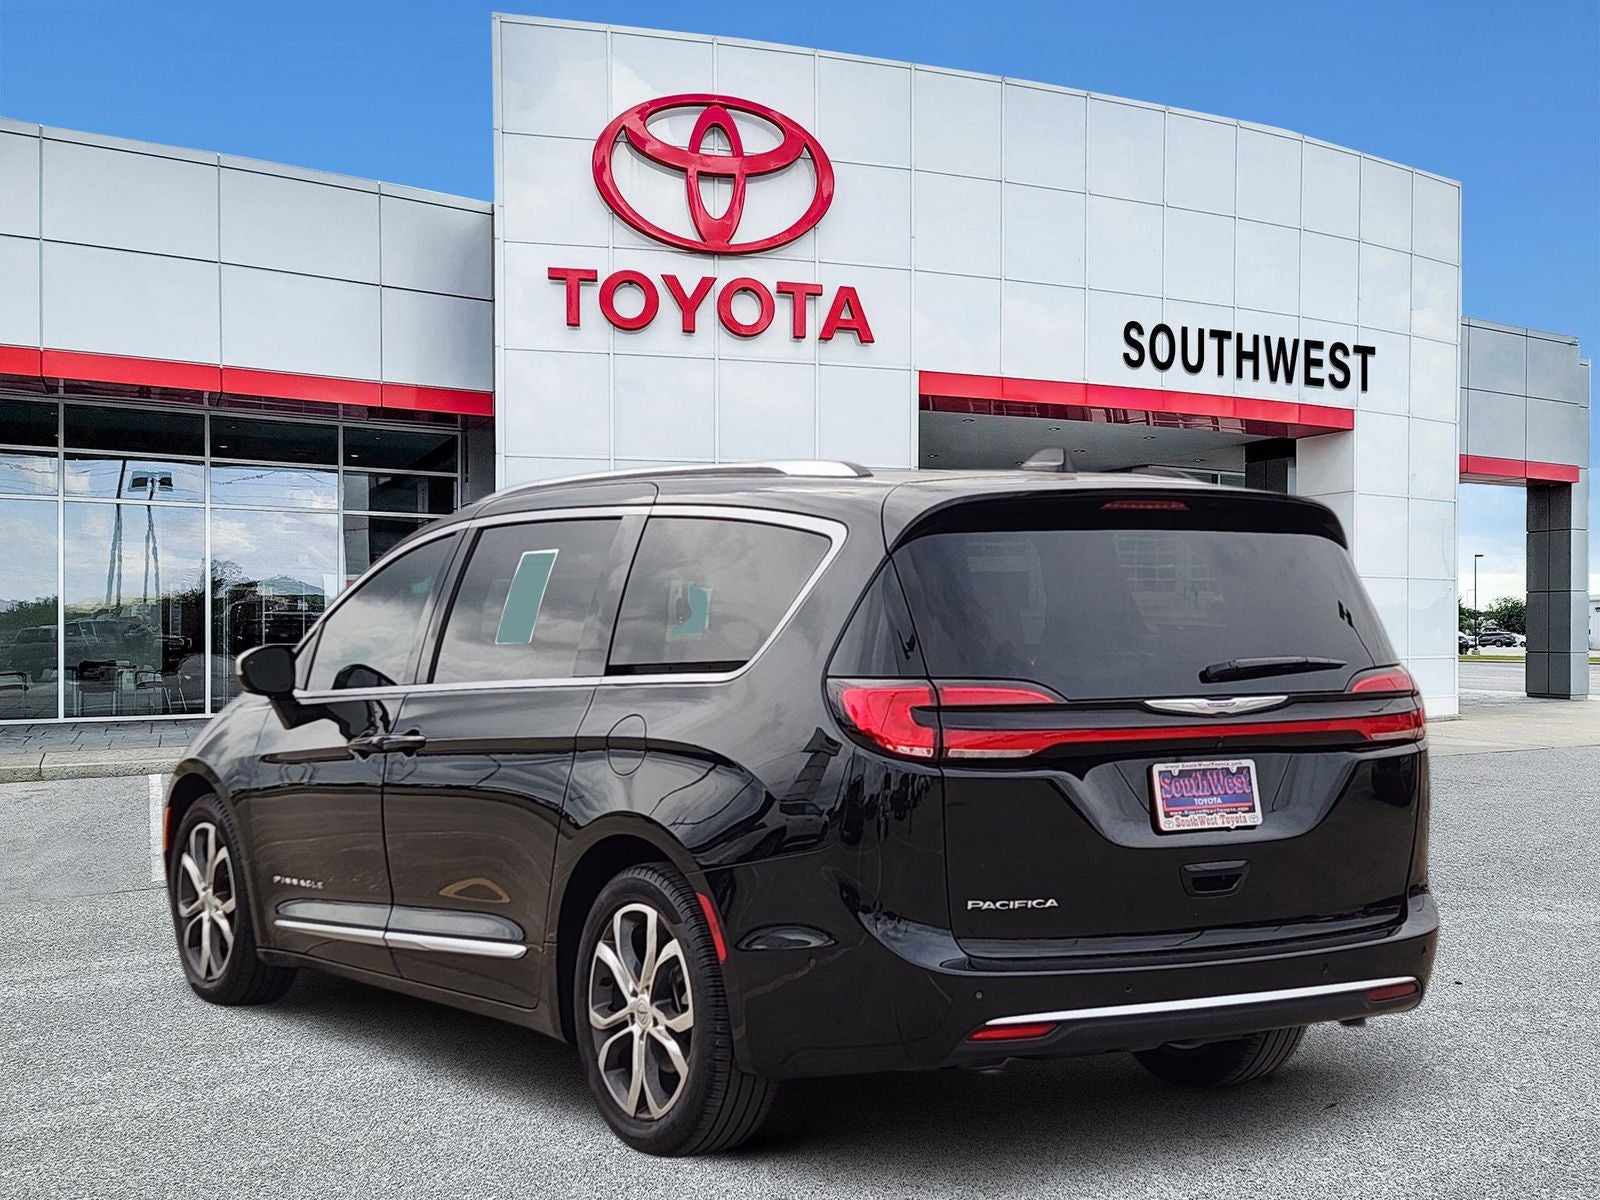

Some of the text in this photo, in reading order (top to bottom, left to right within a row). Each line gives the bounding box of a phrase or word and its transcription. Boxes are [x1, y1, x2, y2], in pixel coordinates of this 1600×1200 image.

[548, 266, 875, 344] TOYOTA
[1123, 320, 1376, 392] SOUTHWEST
[1160, 769, 1251, 798] SouthWest
[1175, 814, 1248, 827] SouthWest Toyota
[966, 899, 1059, 910] PACIFICA
